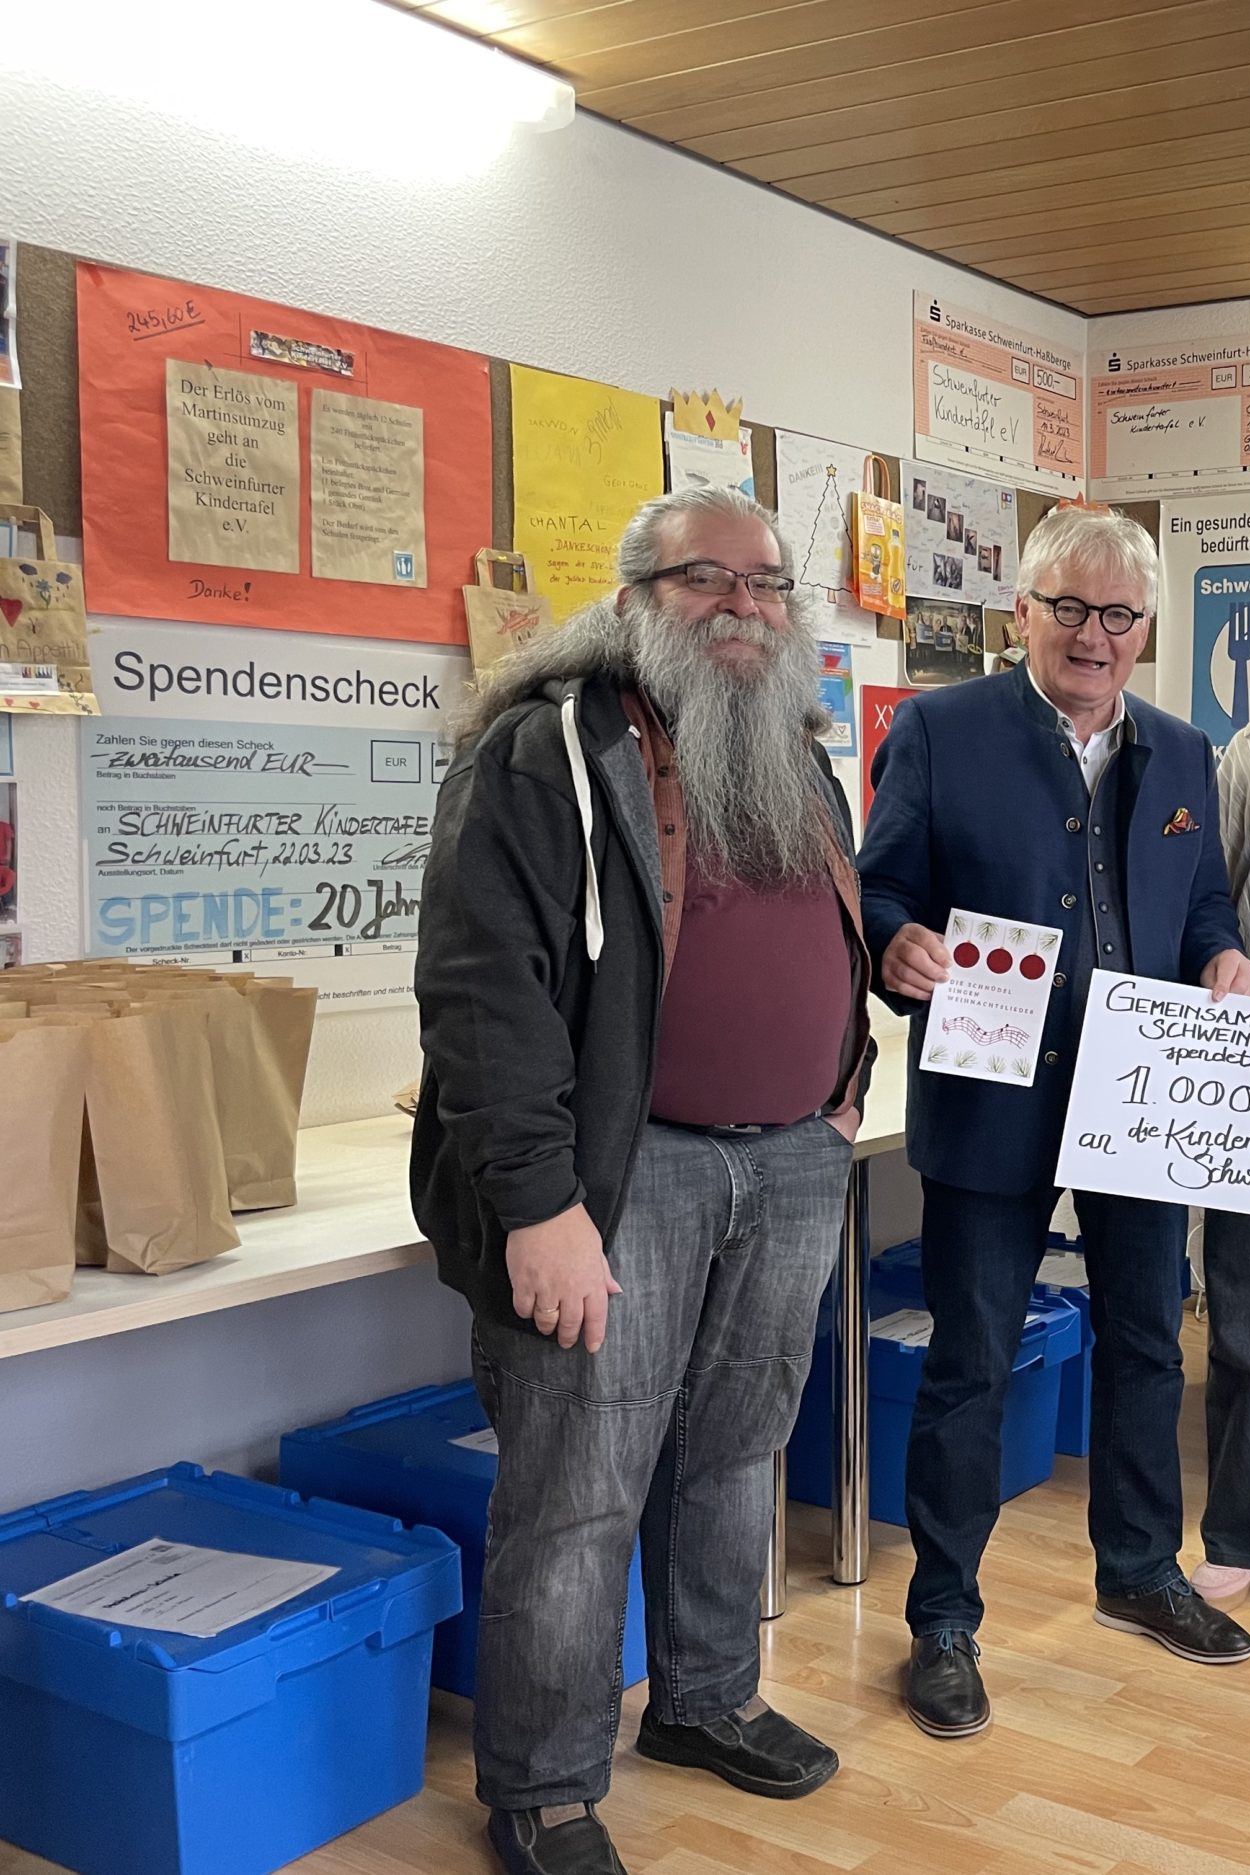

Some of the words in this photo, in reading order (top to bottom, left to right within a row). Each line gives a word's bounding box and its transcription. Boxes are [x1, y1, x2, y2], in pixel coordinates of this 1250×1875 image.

[945, 315, 986, 339] Sparkasse
[988, 330, 1072, 370] Schweinfurt-Haßberge
[1015, 365, 1027, 376] EUR
[1126, 356, 1178, 371] Sparkasse
[1215, 374, 1233, 383] EUR
[181, 380, 208, 397] Der
[214, 385, 251, 405] Erlös
[256, 396, 285, 411] vom
[933, 364, 1002, 413] Schweinfurter
[182, 401, 285, 436] Martinsumzug
[934, 395, 995, 443] Kindertafel
[207, 430, 238, 445] geht
[243, 438, 259, 449] an
[225, 453, 247, 468] die
[185, 468, 285, 495] Schweinfurter
[196, 492, 274, 515] Kindertafel
[222, 519, 249, 533] e.V.
[530, 515, 607, 535] CHANTAL
[1171, 517, 1192, 533] Ein
[906, 556, 923, 572] für
[187, 579, 251, 601] Danke!
[113, 650, 441, 710] Spendenscheck
[96, 733, 136, 747] Zahlen
[139, 736, 157, 747] Sie
[161, 739, 195, 751] gegen
[198, 738, 234, 750] diesen
[236, 738, 275, 751] Scheck
[261, 751, 316, 777] EUR
[385, 757, 407, 768] EUR
[96, 770, 122, 780] Betrag
[124, 771, 131, 779] in
[132, 771, 176, 780] Buchstaben
[97, 804, 116, 812] noch
[118, 804, 143, 813] Betrag
[153, 804, 196, 813] Buchstaben
[97, 825, 111, 834] an
[272, 842, 354, 866] 22.03.23
[98, 868, 158, 877] Ausstellungsort,
[159, 867, 184, 876] Datum
[307, 881, 362, 931] 20
[97, 887, 303, 946] SPENDE:
[333, 989, 371, 998] beschriften
[948, 988, 979, 997] SINGEN
[968, 982, 1012, 995] SCHNÜDEL
[948, 996, 1034, 1015] WEIHNACHTSLIEDER
[1078, 1132, 1117, 1155] an
[1128, 1116, 1161, 1143] die
